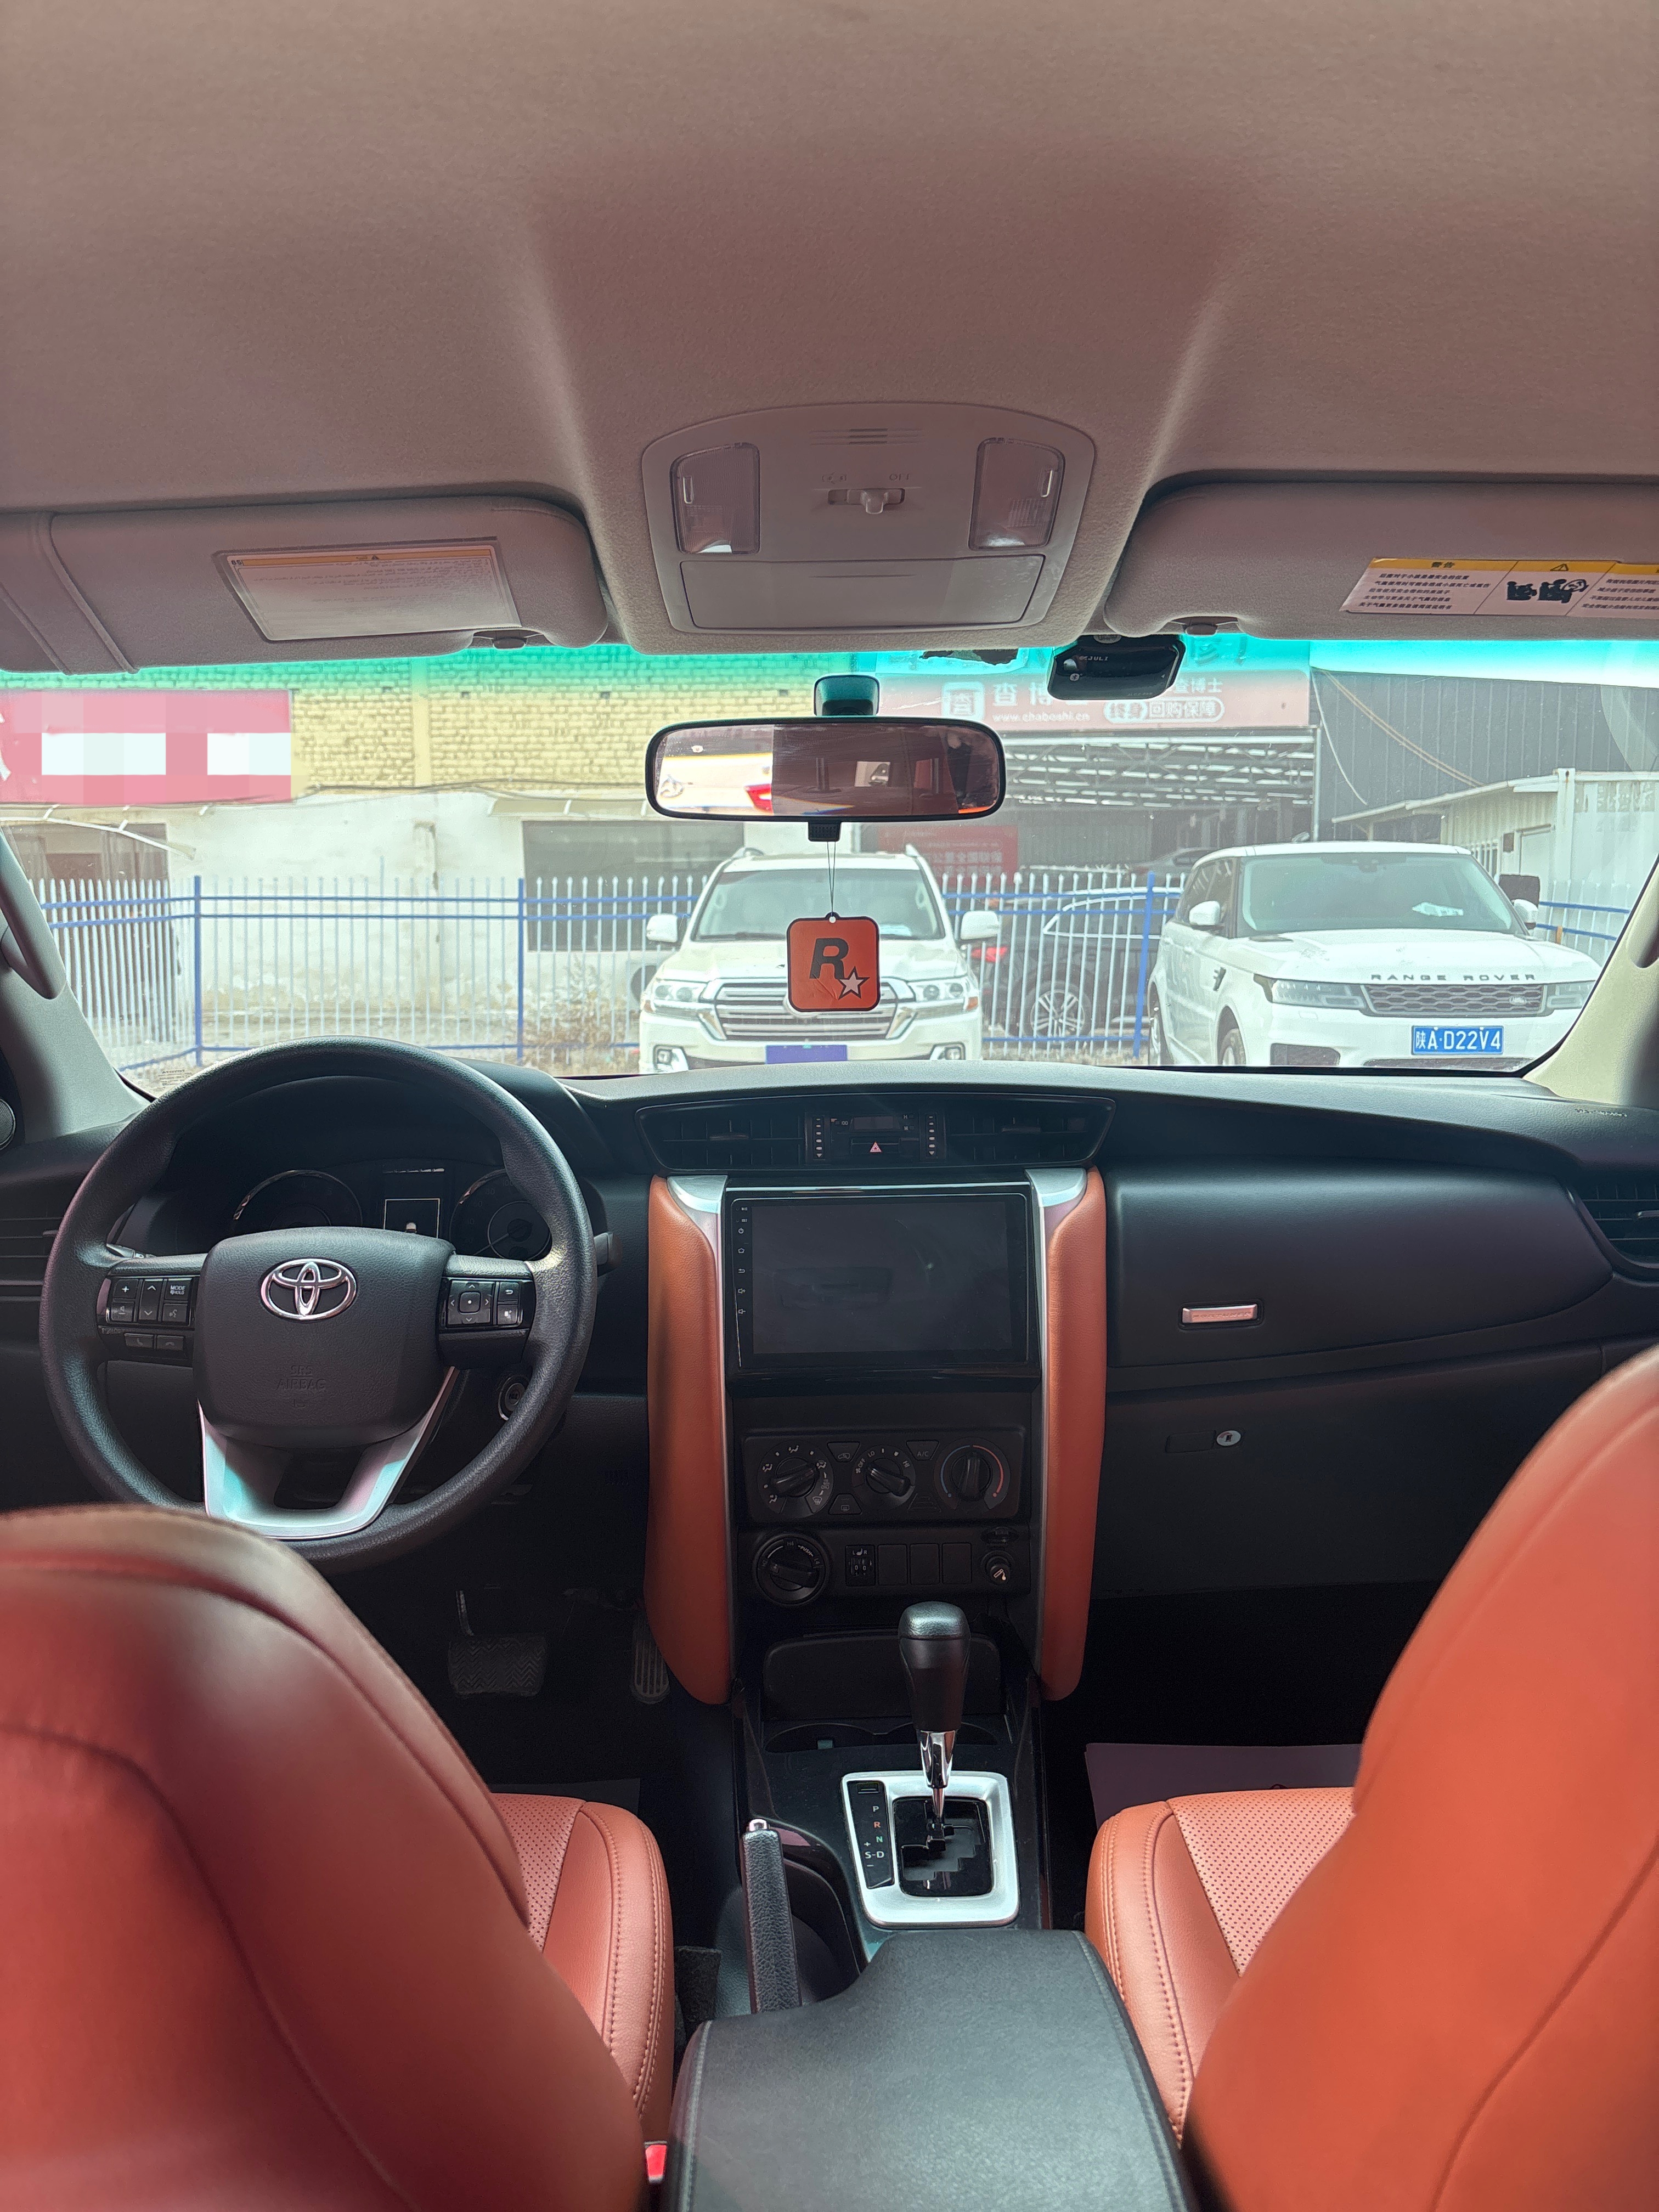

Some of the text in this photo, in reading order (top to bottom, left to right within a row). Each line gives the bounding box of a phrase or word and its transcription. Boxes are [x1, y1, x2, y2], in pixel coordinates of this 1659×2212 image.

[809, 938, 849, 979] R
[290, 1364, 313, 1375] SRS
[276, 1378, 326, 1389] AIRBAG
